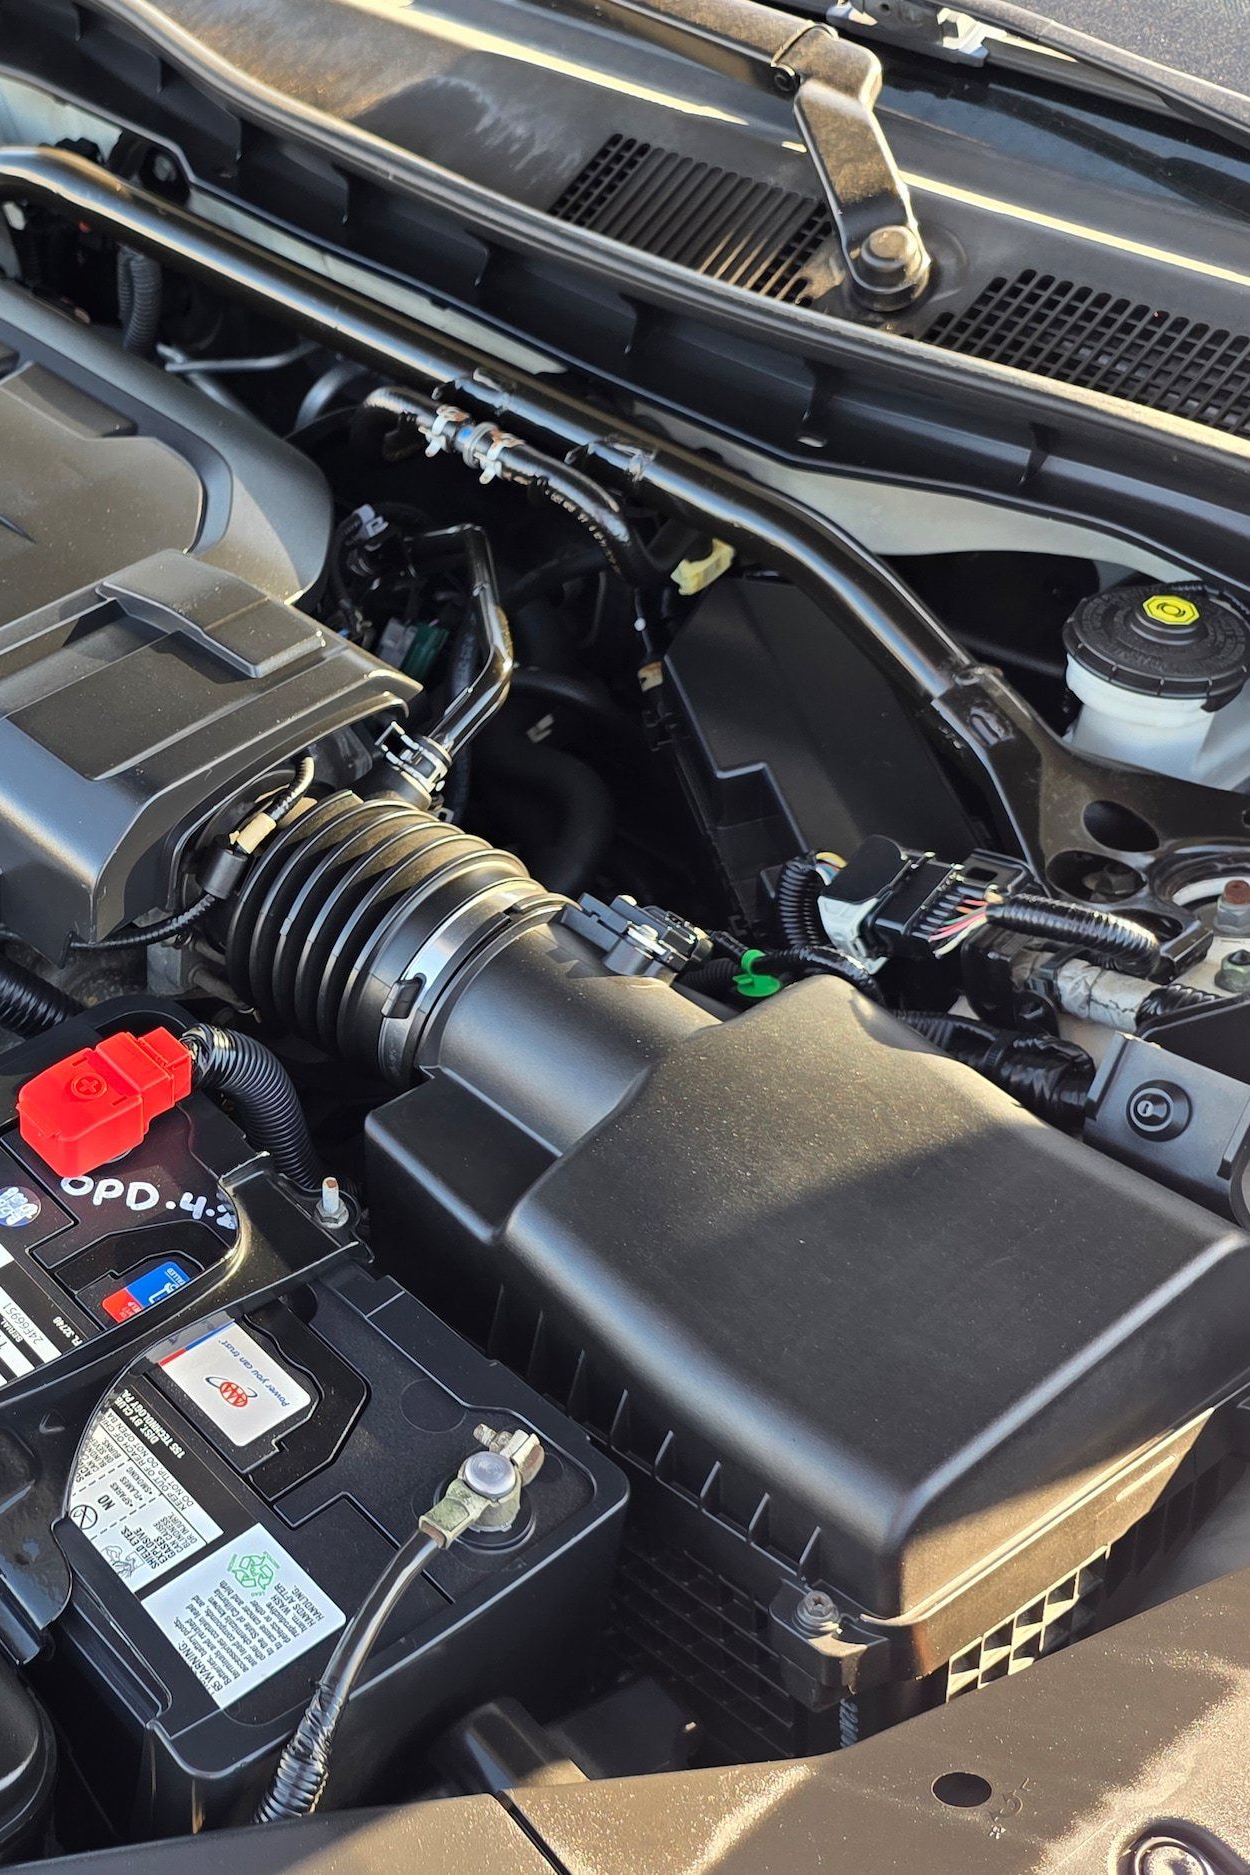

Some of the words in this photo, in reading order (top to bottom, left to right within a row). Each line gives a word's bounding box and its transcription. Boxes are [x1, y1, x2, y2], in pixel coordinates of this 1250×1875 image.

[1, 1316, 23, 1342] SERIAL
[239, 1357, 252, 1369] can
[251, 1369, 269, 1383] you
[219, 1382, 247, 1407] AAA
[265, 1384, 289, 1406] Power
[129, 1414, 143, 1426] BY
[130, 1401, 172, 1445] TECHNOLOGY
[112, 1432, 124, 1442] OF
[115, 1422, 134, 1442] OPEN
[139, 1423, 159, 1443] DIST.
[101, 1437, 121, 1459] BURNS.
[122, 1442, 145, 1467] REACH
[133, 1442, 148, 1457] NOT
[169, 1442, 184, 1458] 155
[86, 1460, 99, 1472] CAN
[103, 1453, 114, 1463] OR
[146, 1456, 158, 1468] DO
[143, 1466, 155, 1476] OF
[152, 1477, 168, 1491] OUT
[167, 1480, 183, 1495] NOT
[97, 1494, 114, 1510] NO
[167, 1492, 186, 1510] KEEP
[181, 1495, 194, 1506] DO
[153, 1521, 172, 1540] CAUSE
[160, 1516, 190, 1548] BLINDNESS
[186, 1533, 197, 1543] OR
[134, 1527, 167, 1563] EXPLOSIVE
[153, 1536, 175, 1558] GASES
[169, 1539, 183, 1552] CAN
[135, 1545, 159, 1568] SHIELD
[219, 1580, 233, 1595] birth
[274, 1582, 295, 1603] AFTER
[191, 1594, 205, 1607] and
[207, 1596, 226, 1617] known
[213, 1588, 239, 1617] California
[230, 1593, 244, 1606] and
[249, 1600, 265, 1615] other
[270, 1594, 290, 1615] WASH
[291, 1585, 323, 1621] HANDLING.
[185, 1603, 200, 1618] lead
[241, 1605, 261, 1625] cancer
[263, 1614, 272, 1622] or
[266, 1600, 298, 1637] reproductive
[292, 1603, 315, 1626] HANDS
[184, 1618, 205, 1639] related
[198, 1616, 219, 1638] contain
[224, 1615, 251, 1644] chemicals
[243, 1622, 259, 1639] State
[259, 1624, 276, 1642] cause
[270, 1621, 290, 1643] defects
[187, 1633, 207, 1657] battery
[202, 1638, 216, 1650] and
[231, 1640, 246, 1655] lead
[257, 1637, 268, 1649] the
[266, 1647, 274, 1655] to
[274, 1641, 282, 1650] to
[217, 1638, 248, 1672] accessories
[243, 1653, 257, 1666] and
[250, 1645, 265, 1660] other
[206, 1655, 231, 1685] Batteries,
[214, 1650, 240, 1679] terminals
[211, 1680, 223, 1691] 65
